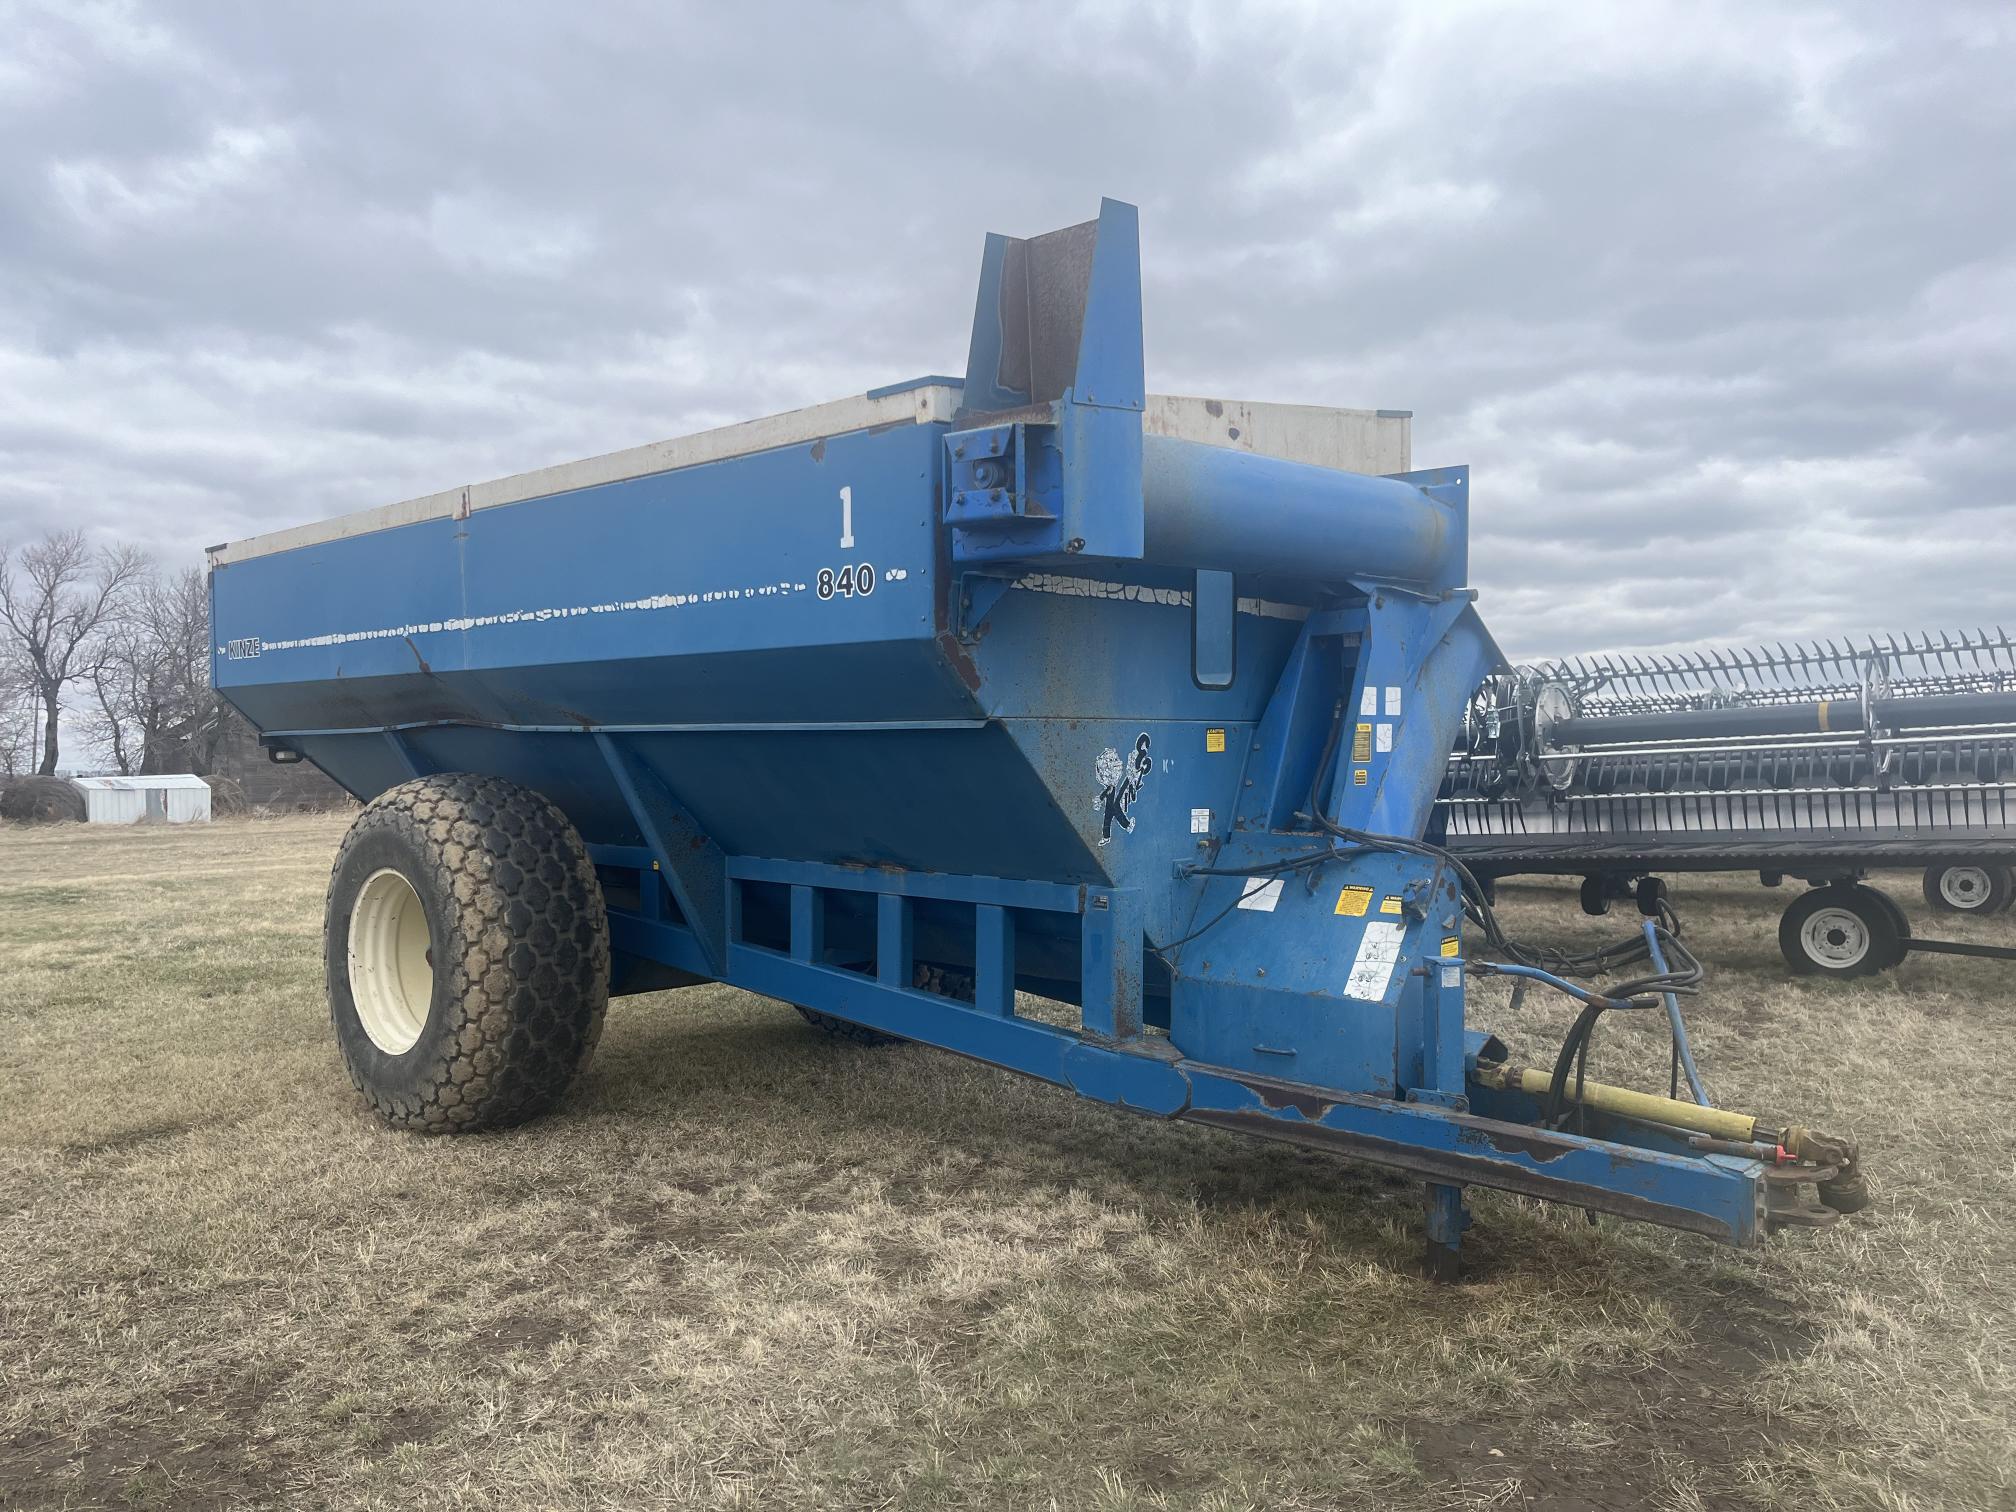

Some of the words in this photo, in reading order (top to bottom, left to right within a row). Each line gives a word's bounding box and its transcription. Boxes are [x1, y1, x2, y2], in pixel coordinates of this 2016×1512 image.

[840, 486, 855, 549] 1
[817, 562, 876, 601] 840
[228, 637, 261, 660] KINZE
